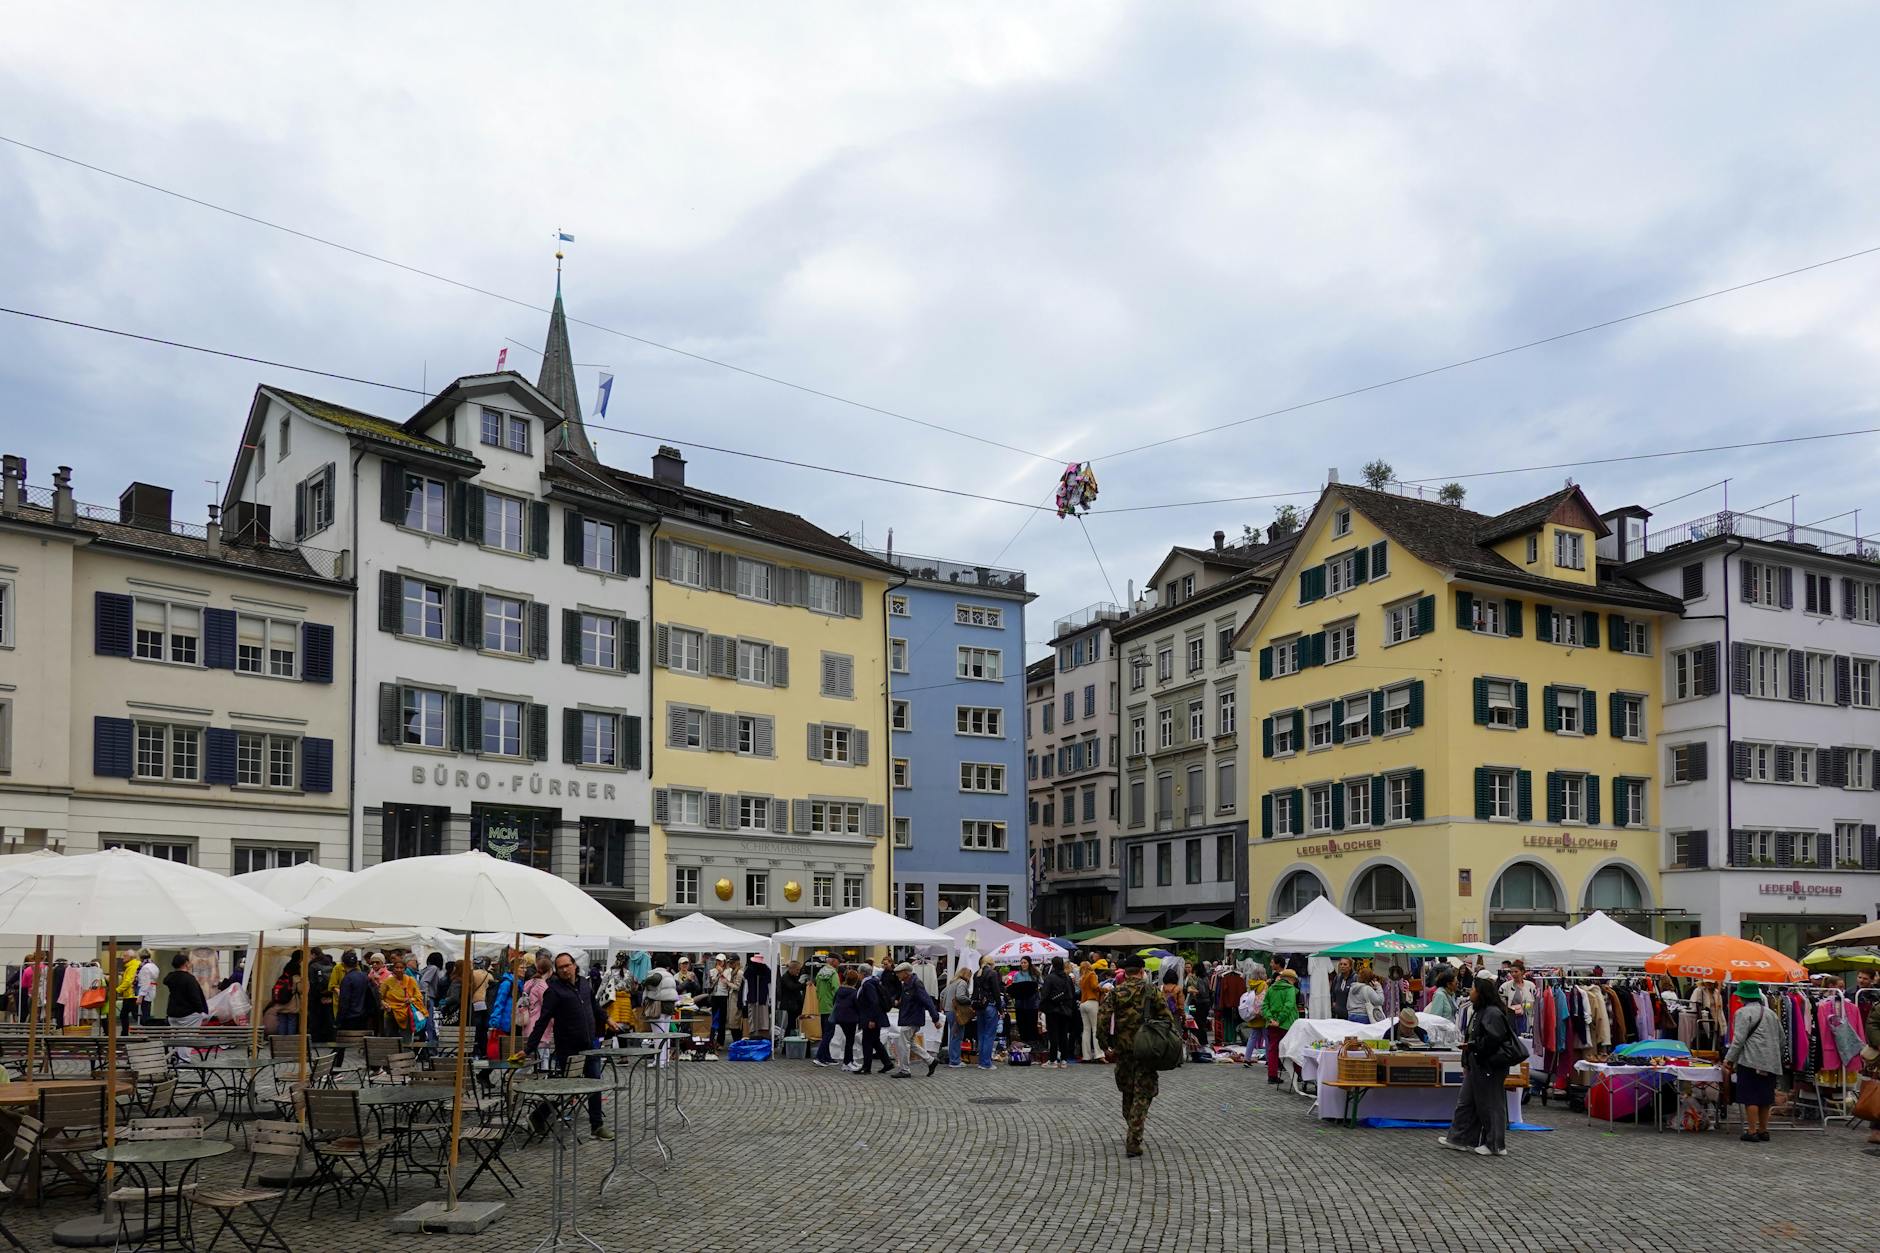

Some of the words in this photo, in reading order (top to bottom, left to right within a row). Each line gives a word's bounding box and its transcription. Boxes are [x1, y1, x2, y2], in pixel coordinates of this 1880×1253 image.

[412, 763, 616, 800] BÜRO-FÜRRER
[488, 827, 519, 840] MCM
[1297, 844, 1329, 855] LEDER
[1337, 840, 1381, 852] LOCHER
[1524, 836, 1562, 846] LEDER
[1573, 838, 1618, 848] LOCHER
[1759, 884, 1793, 893] LEDER
[1801, 885, 1842, 894] LOCHER
[1679, 965, 1714, 976] coop
